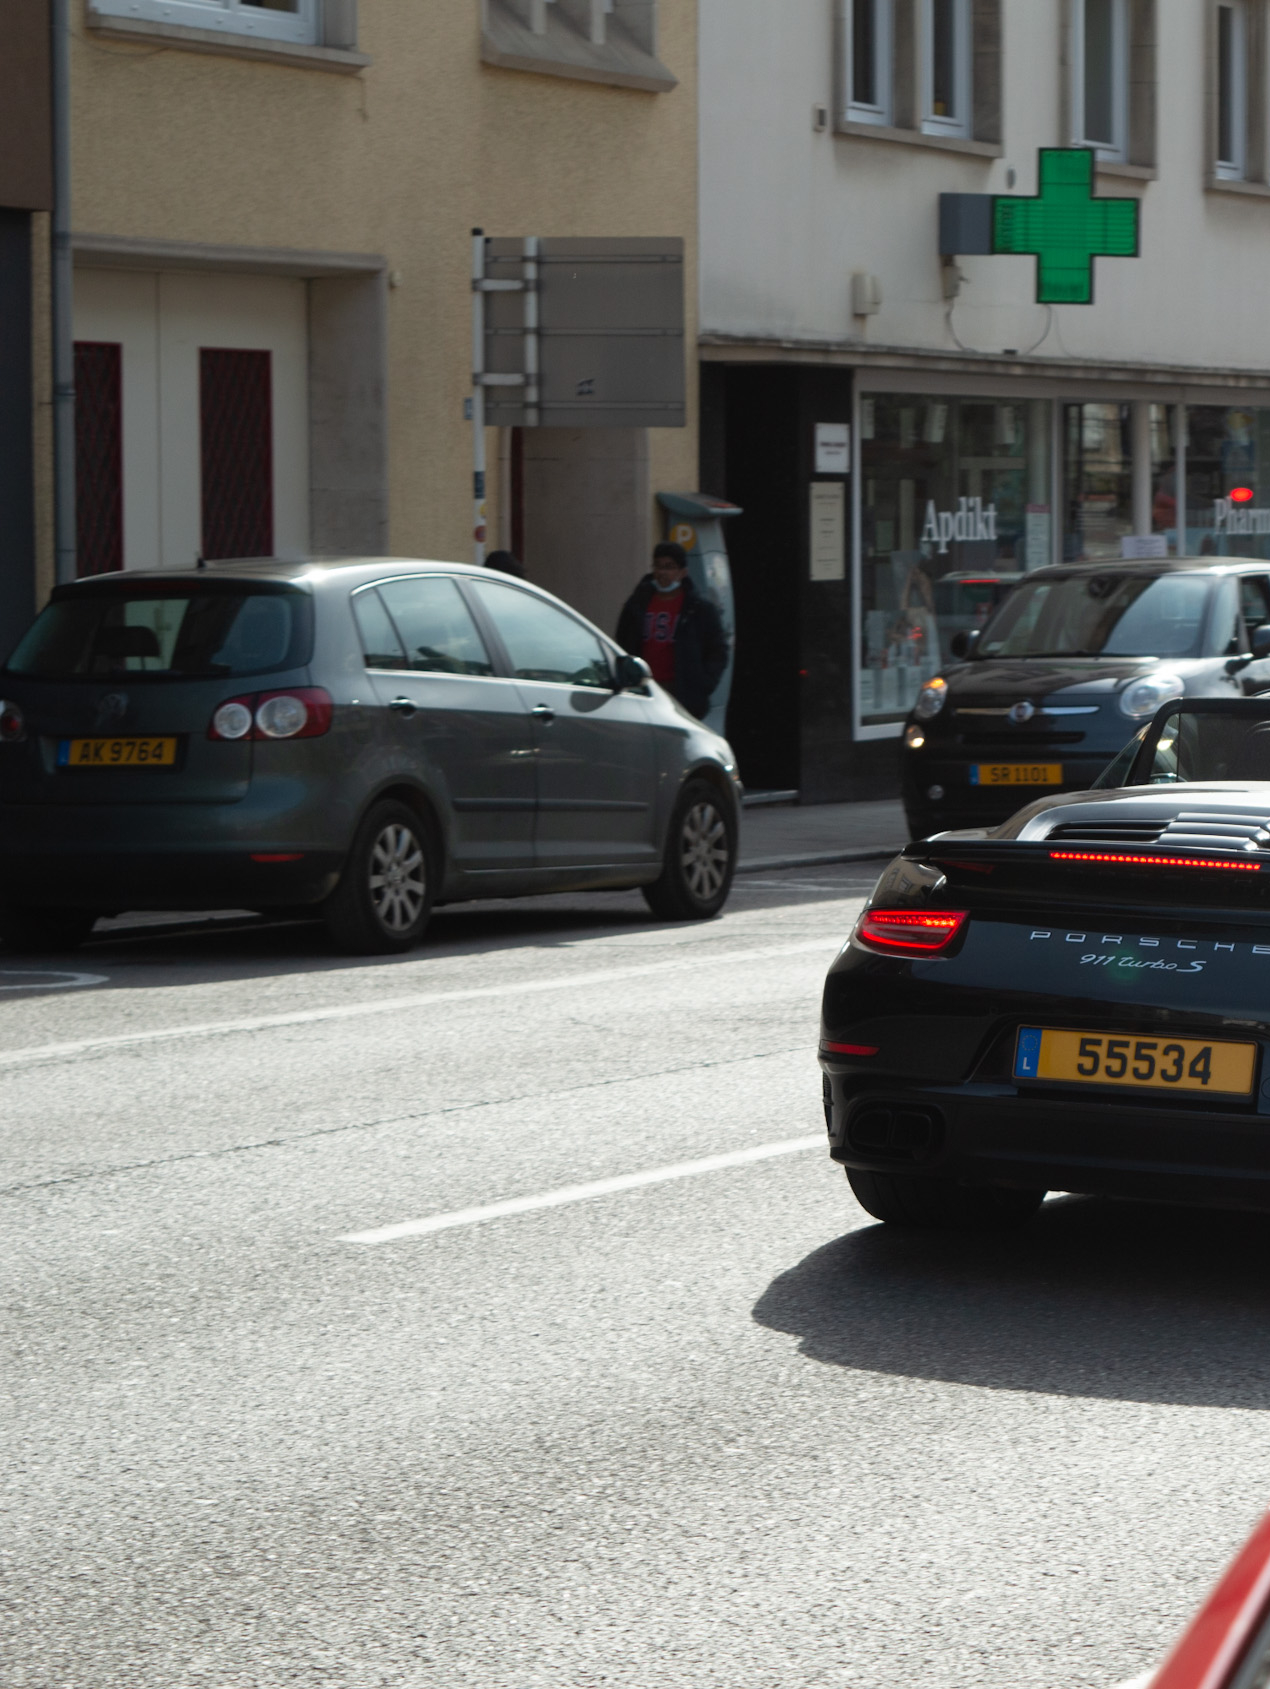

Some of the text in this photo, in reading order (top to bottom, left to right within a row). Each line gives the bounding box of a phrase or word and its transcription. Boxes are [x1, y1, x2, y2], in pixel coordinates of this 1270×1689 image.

[921, 496, 997, 554] Apdikt
[79, 742, 105, 762] AK
[110, 741, 165, 762] 9764
[1015, 766, 1048, 782] 1101
[1080, 953, 1207, 972] 911 turbo S
[1022, 1038, 1212, 1085] L 55534
